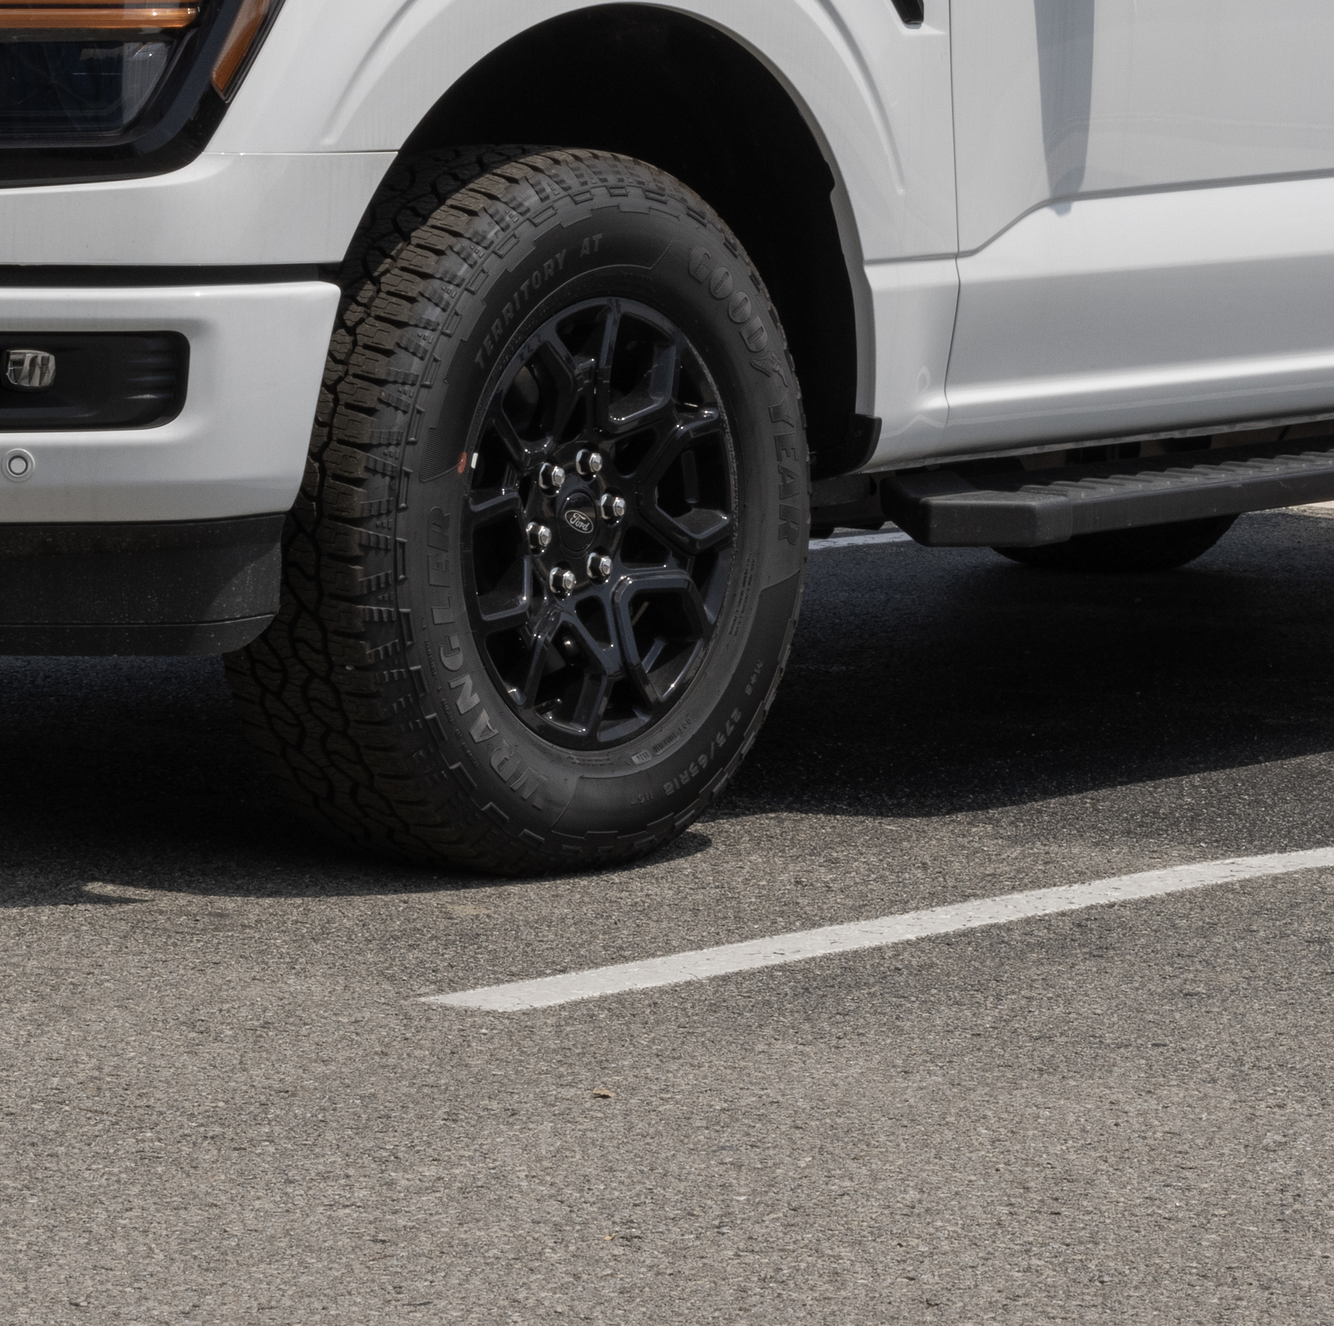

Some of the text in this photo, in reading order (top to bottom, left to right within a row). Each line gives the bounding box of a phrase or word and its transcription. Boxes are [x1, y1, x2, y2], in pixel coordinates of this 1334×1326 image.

[474, 232, 604, 370] TERRITORY AT
[569, 512, 590, 531] Ford
[427, 506, 549, 811] WRANGLER
[663, 706, 742, 796] 275/65R18
